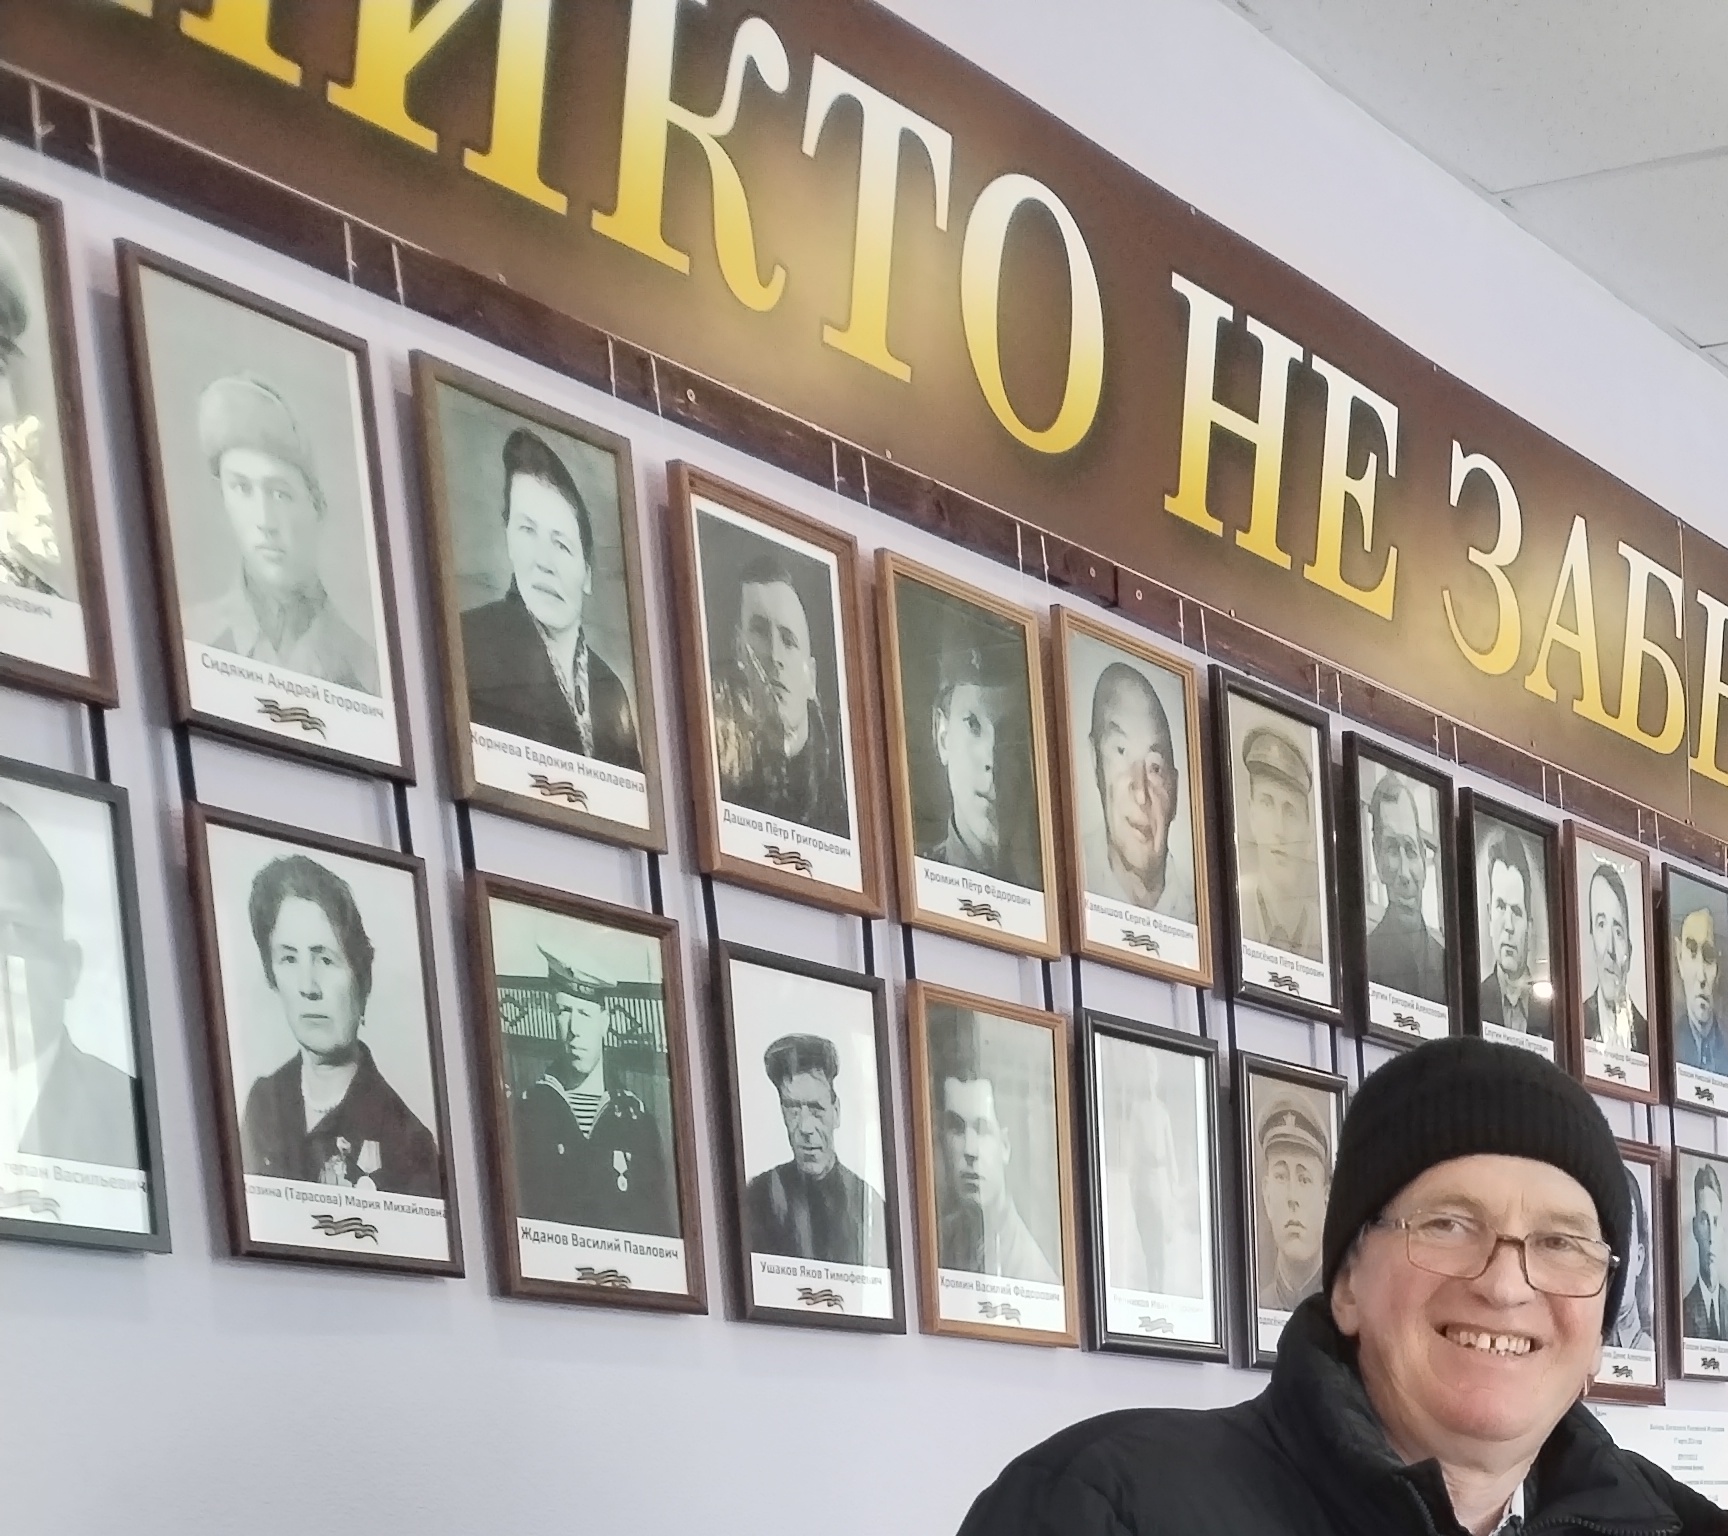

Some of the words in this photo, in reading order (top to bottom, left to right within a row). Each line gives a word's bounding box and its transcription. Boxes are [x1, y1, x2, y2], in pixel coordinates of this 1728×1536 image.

[112, 0, 1105, 454] ИКТО
[1164, 270, 1400, 620] НЕ
[201, 653, 264, 684] Сидякин
[268, 672, 320, 699] Андрей
[324, 688, 385, 719] Егорович
[525, 746, 574, 772] Евдокия
[578, 761, 645, 793] Николаевна
[723, 808, 763, 832] Дашков
[766, 821, 789, 840] Пётр
[791, 829, 851, 857] Григорьевич
[962, 877, 983, 895] Пётр
[246, 1183, 282, 1198] озина
[285, 1187, 343, 1208] (Тарасова)
[345, 1195, 382, 1211] Мария
[521, 1226, 569, 1246] Жданов
[572, 1233, 621, 1253] Василий
[624, 1240, 679, 1260] Павлович
[760, 1261, 797, 1277] Ушаков
[799, 1265, 822, 1279] Яков
